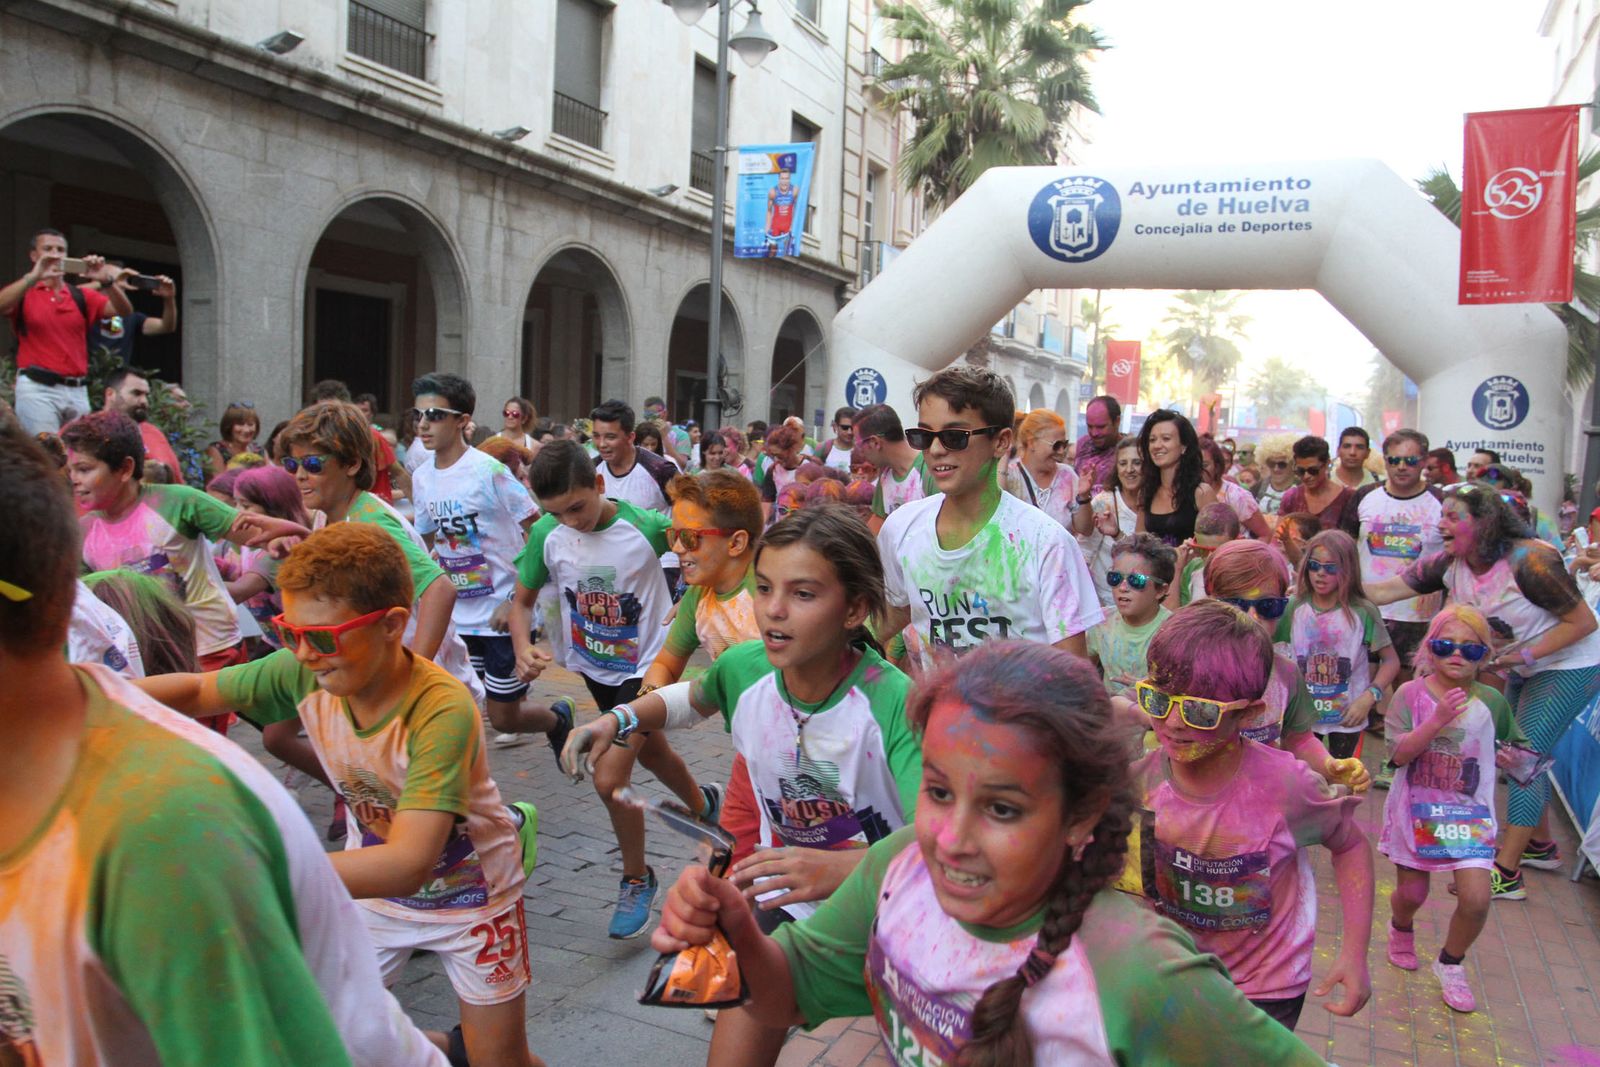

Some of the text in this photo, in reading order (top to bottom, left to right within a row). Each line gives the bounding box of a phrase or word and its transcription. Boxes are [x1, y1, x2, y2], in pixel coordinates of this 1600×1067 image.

[1128, 176, 1312, 200] Ayuntamiento
[1177, 195, 1311, 217] de Huelva
[1218, 222, 1236, 233] de
[1241, 220, 1313, 234] Deportes
[1445, 439, 1545, 452] Ayuntamiento
[1499, 451, 1544, 465] Huelva
[584, 635, 616, 656] 504
[1433, 823, 1472, 840] 489
[1193, 857, 1244, 870] DIPUTACIÓN
[1206, 866, 1240, 875] HUELVA
[1179, 879, 1235, 908] 138
[1220, 911, 1269, 928] Colors
[471, 910, 517, 966] 25
[484, 971, 515, 985] adidas
